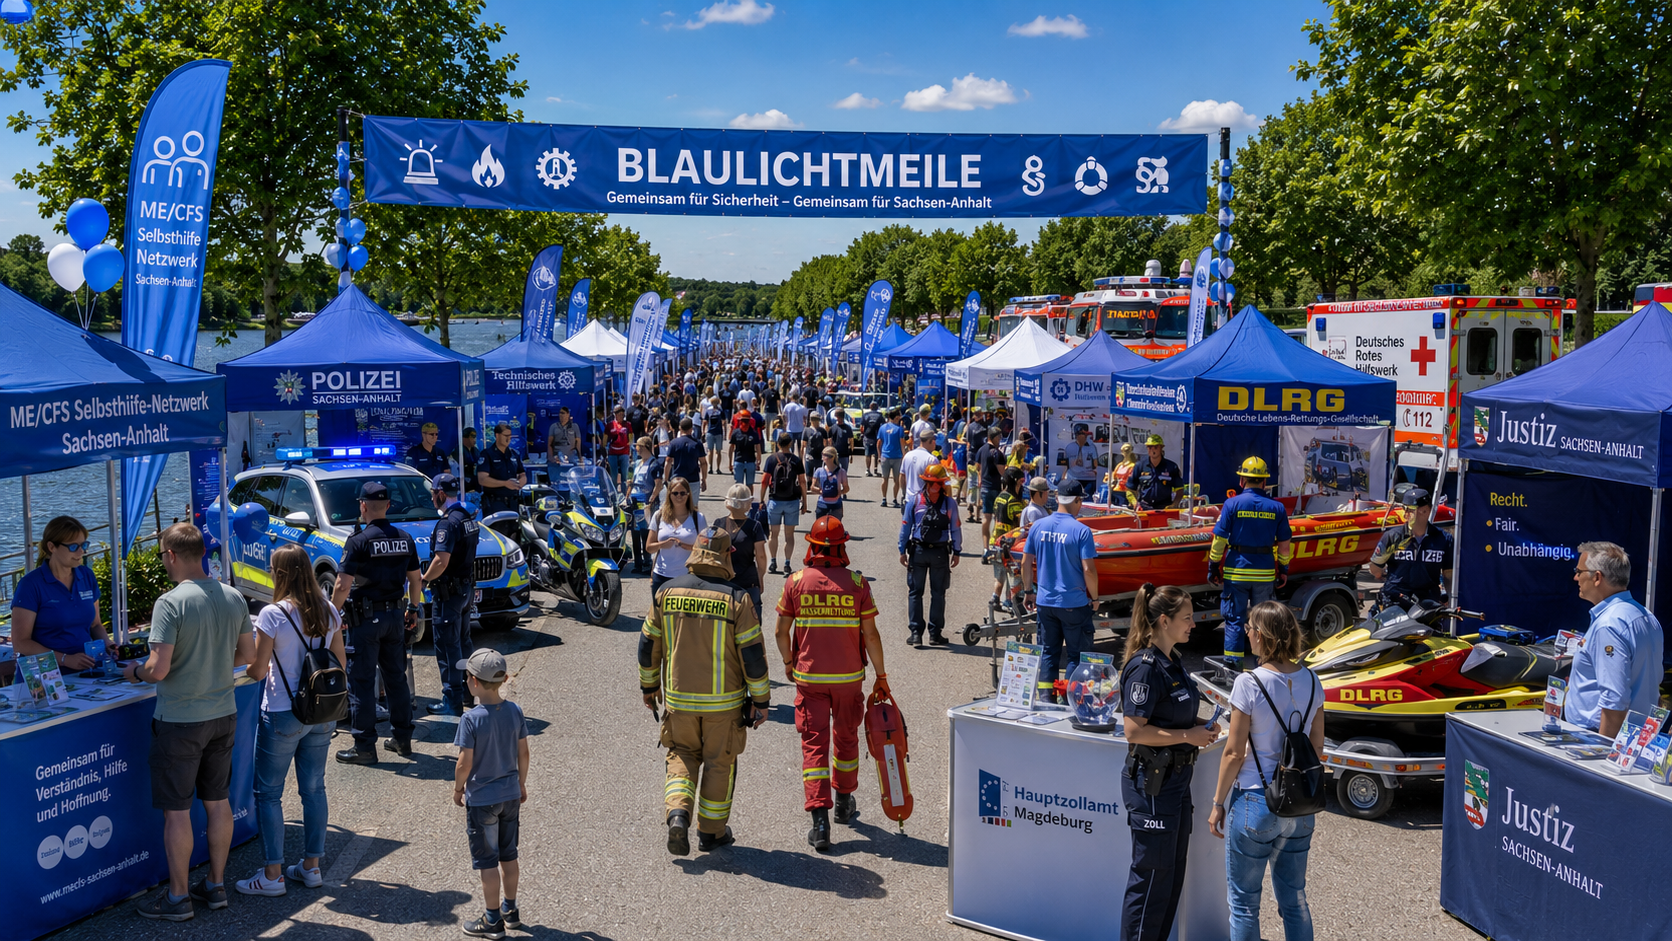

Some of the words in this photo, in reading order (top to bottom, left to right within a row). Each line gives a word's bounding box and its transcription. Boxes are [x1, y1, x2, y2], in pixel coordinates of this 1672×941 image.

[617, 147, 982, 188] BLAULICHTMEILE
[606, 190, 686, 205] Gemeinsam
[689, 192, 709, 206] für
[711, 192, 779, 207] Sicherheit
[793, 194, 868, 208] Gemeinsam
[871, 194, 890, 209] für
[893, 195, 992, 209] Sachsen-Anhalt
[140, 200, 204, 222] ME/CFS
[137, 227, 201, 246] Selbsthilfe
[136, 248, 198, 268] Netzwerk
[1355, 335, 1405, 348] Deutsches
[1355, 349, 1383, 362] Rotes
[491, 370, 556, 381] Technisches
[1355, 363, 1399, 377] Hilfswerk
[312, 370, 401, 390] POLIZEI
[1074, 381, 1105, 392] DHW
[312, 393, 402, 405] SACHSEN-ANHALT
[1217, 385, 1346, 412] DLRG
[10, 400, 71, 429] ME/CFS
[1412, 411, 1433, 428] 112
[62, 423, 170, 455] Sachsen-Anhalt
[1496, 410, 1558, 448] Justiz
[1560, 436, 1645, 459] SACHSEN-ANHALT
[1489, 491, 1529, 508] Recht.
[1494, 517, 1520, 532] Fair.
[1040, 530, 1068, 544] THW
[373, 539, 409, 555] POLIZEI
[1497, 541, 1576, 562] Unabhängig.
[665, 597, 726, 616] FEUERWEHR
[800, 594, 855, 607] DLRG
[1339, 688, 1403, 702] DLRG
[35, 752, 98, 781] Gemeinsam
[99, 743, 116, 758] für
[36, 770, 102, 802] Verständnis,
[104, 760, 128, 779] Hilfe
[36, 803, 59, 823] und
[61, 787, 112, 815] Hoffnung.
[1014, 786, 1119, 816] Hauptzollamt
[1014, 805, 1093, 835] Magdeburg
[1143, 819, 1166, 830] ZOLL
[1501, 786, 1576, 854] Justiz
[1501, 835, 1604, 900] SACHSEN-ANHALT
